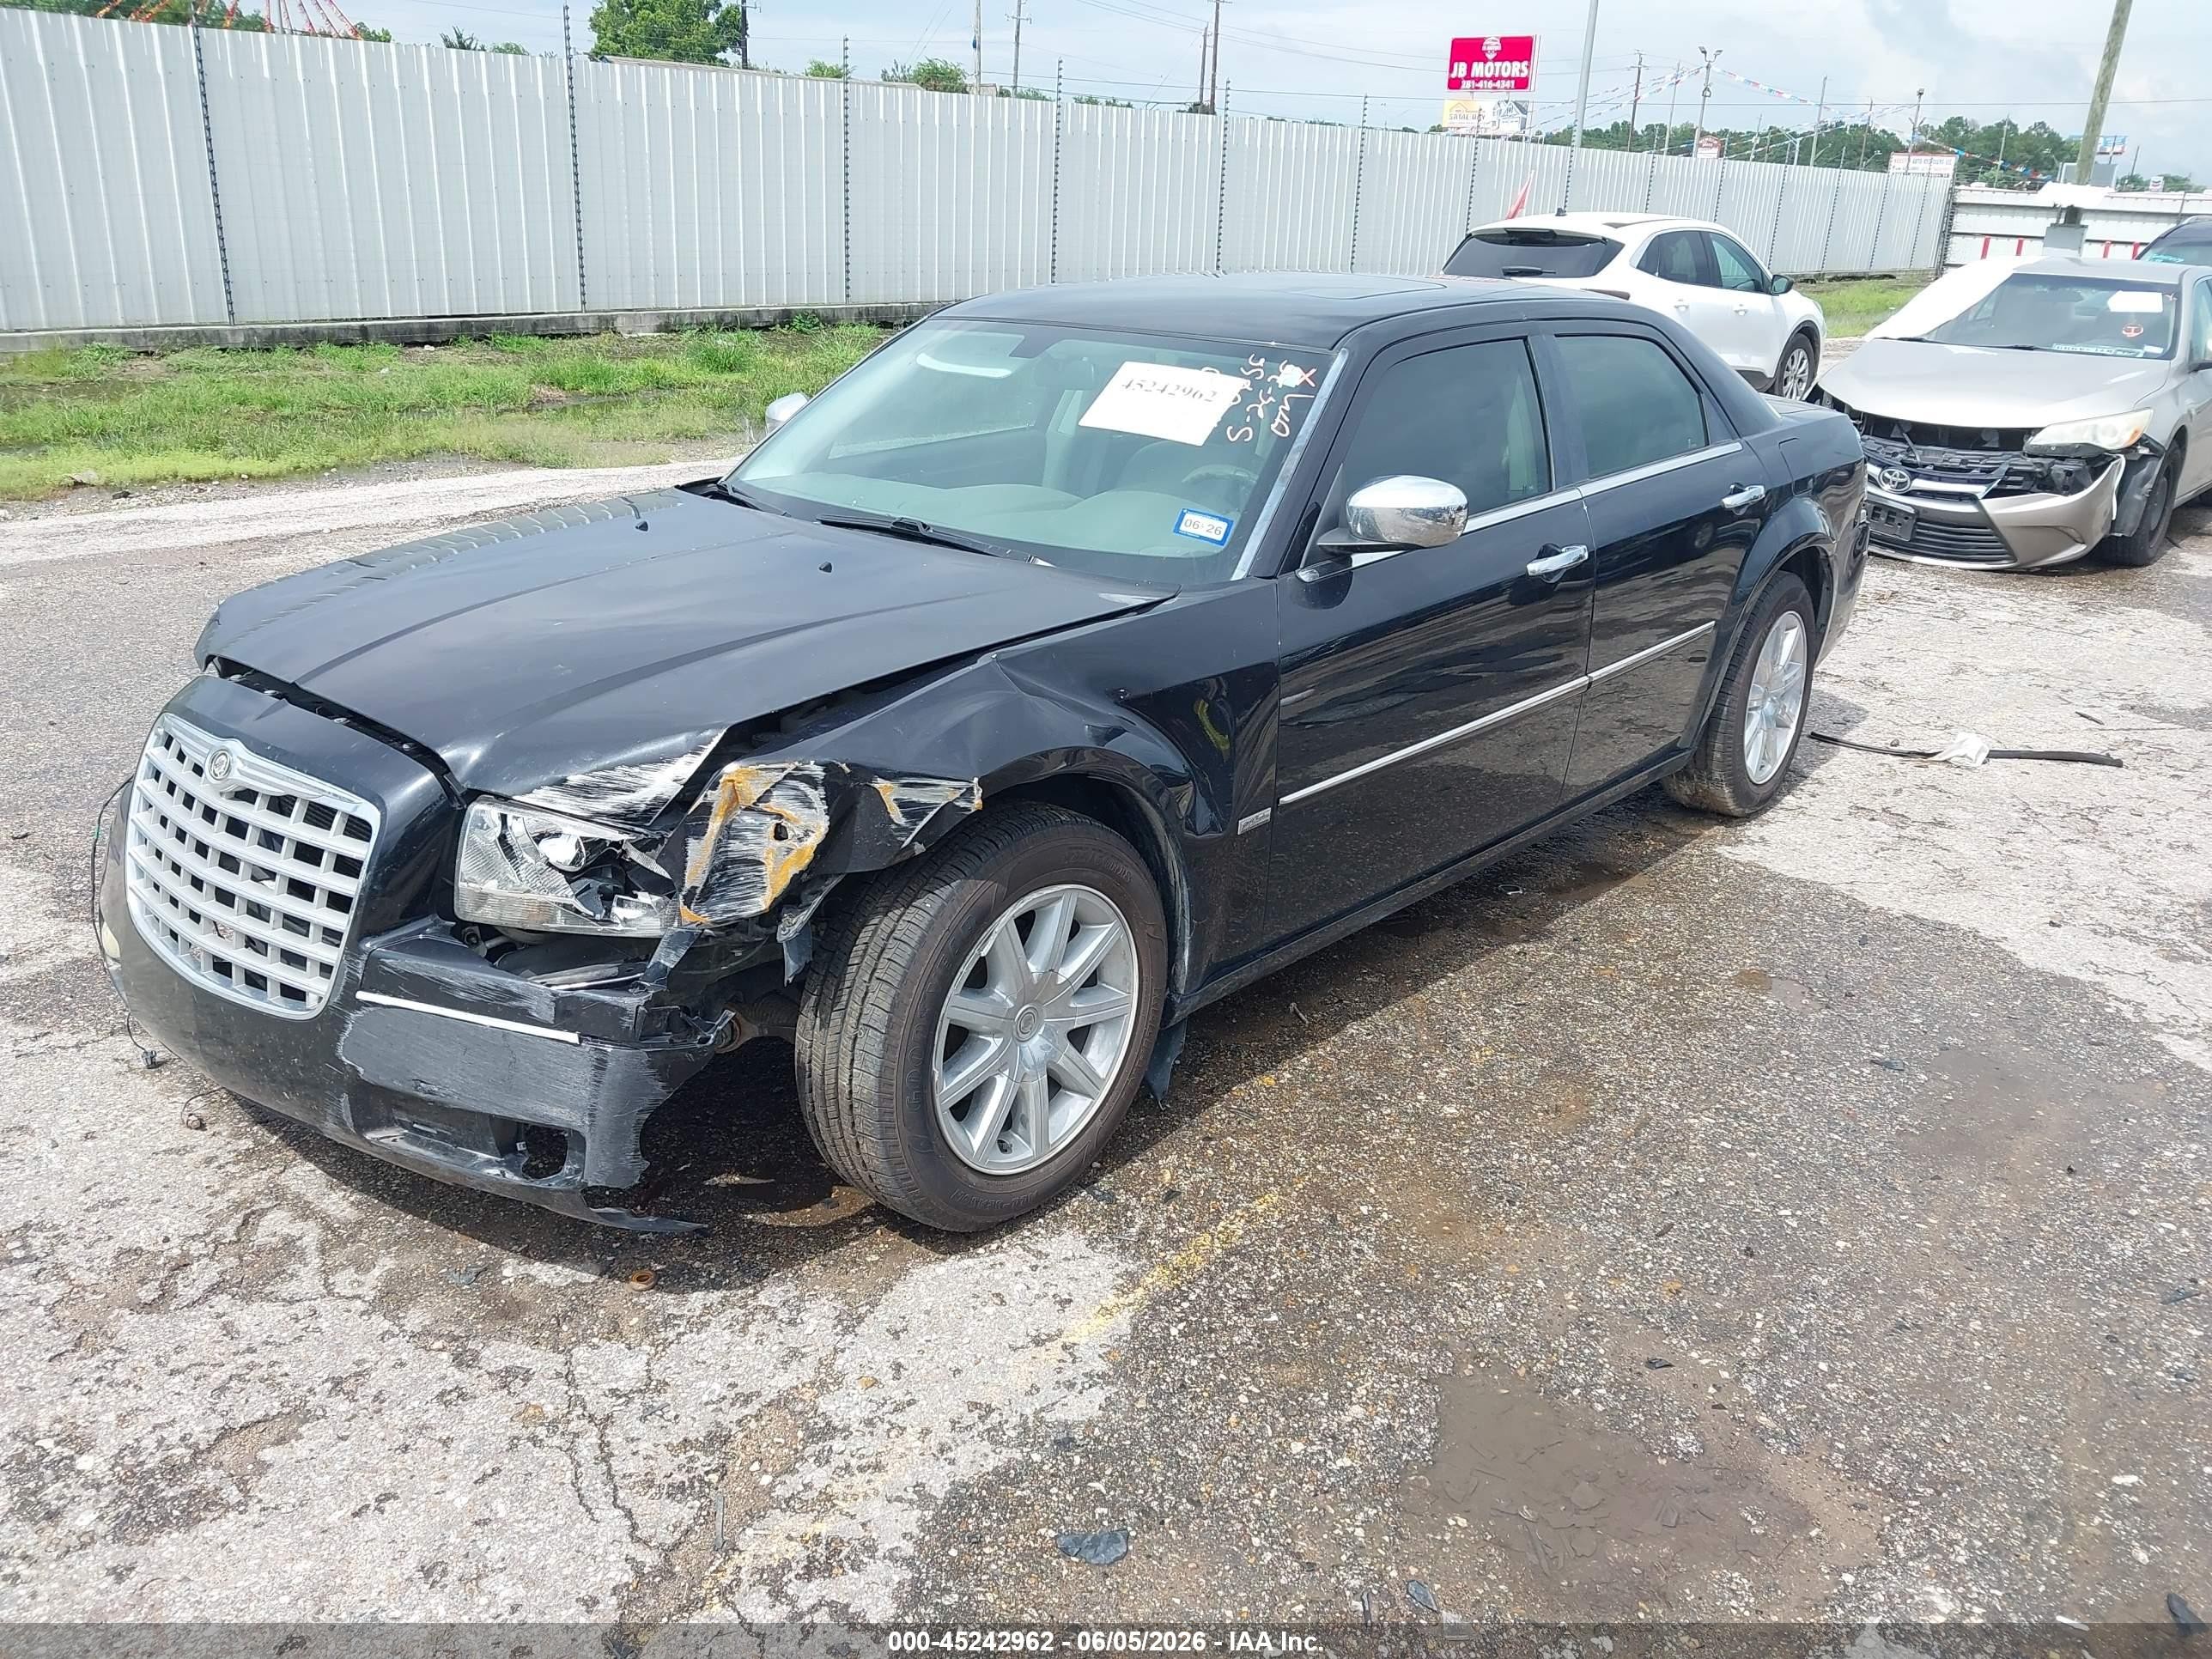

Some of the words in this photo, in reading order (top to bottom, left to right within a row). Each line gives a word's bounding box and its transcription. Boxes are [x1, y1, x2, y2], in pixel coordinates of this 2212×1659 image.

[1451, 61, 1468, 78] JB
[1470, 60, 1528, 78] MOTORS
[1121, 379, 1218, 403] 45242962
